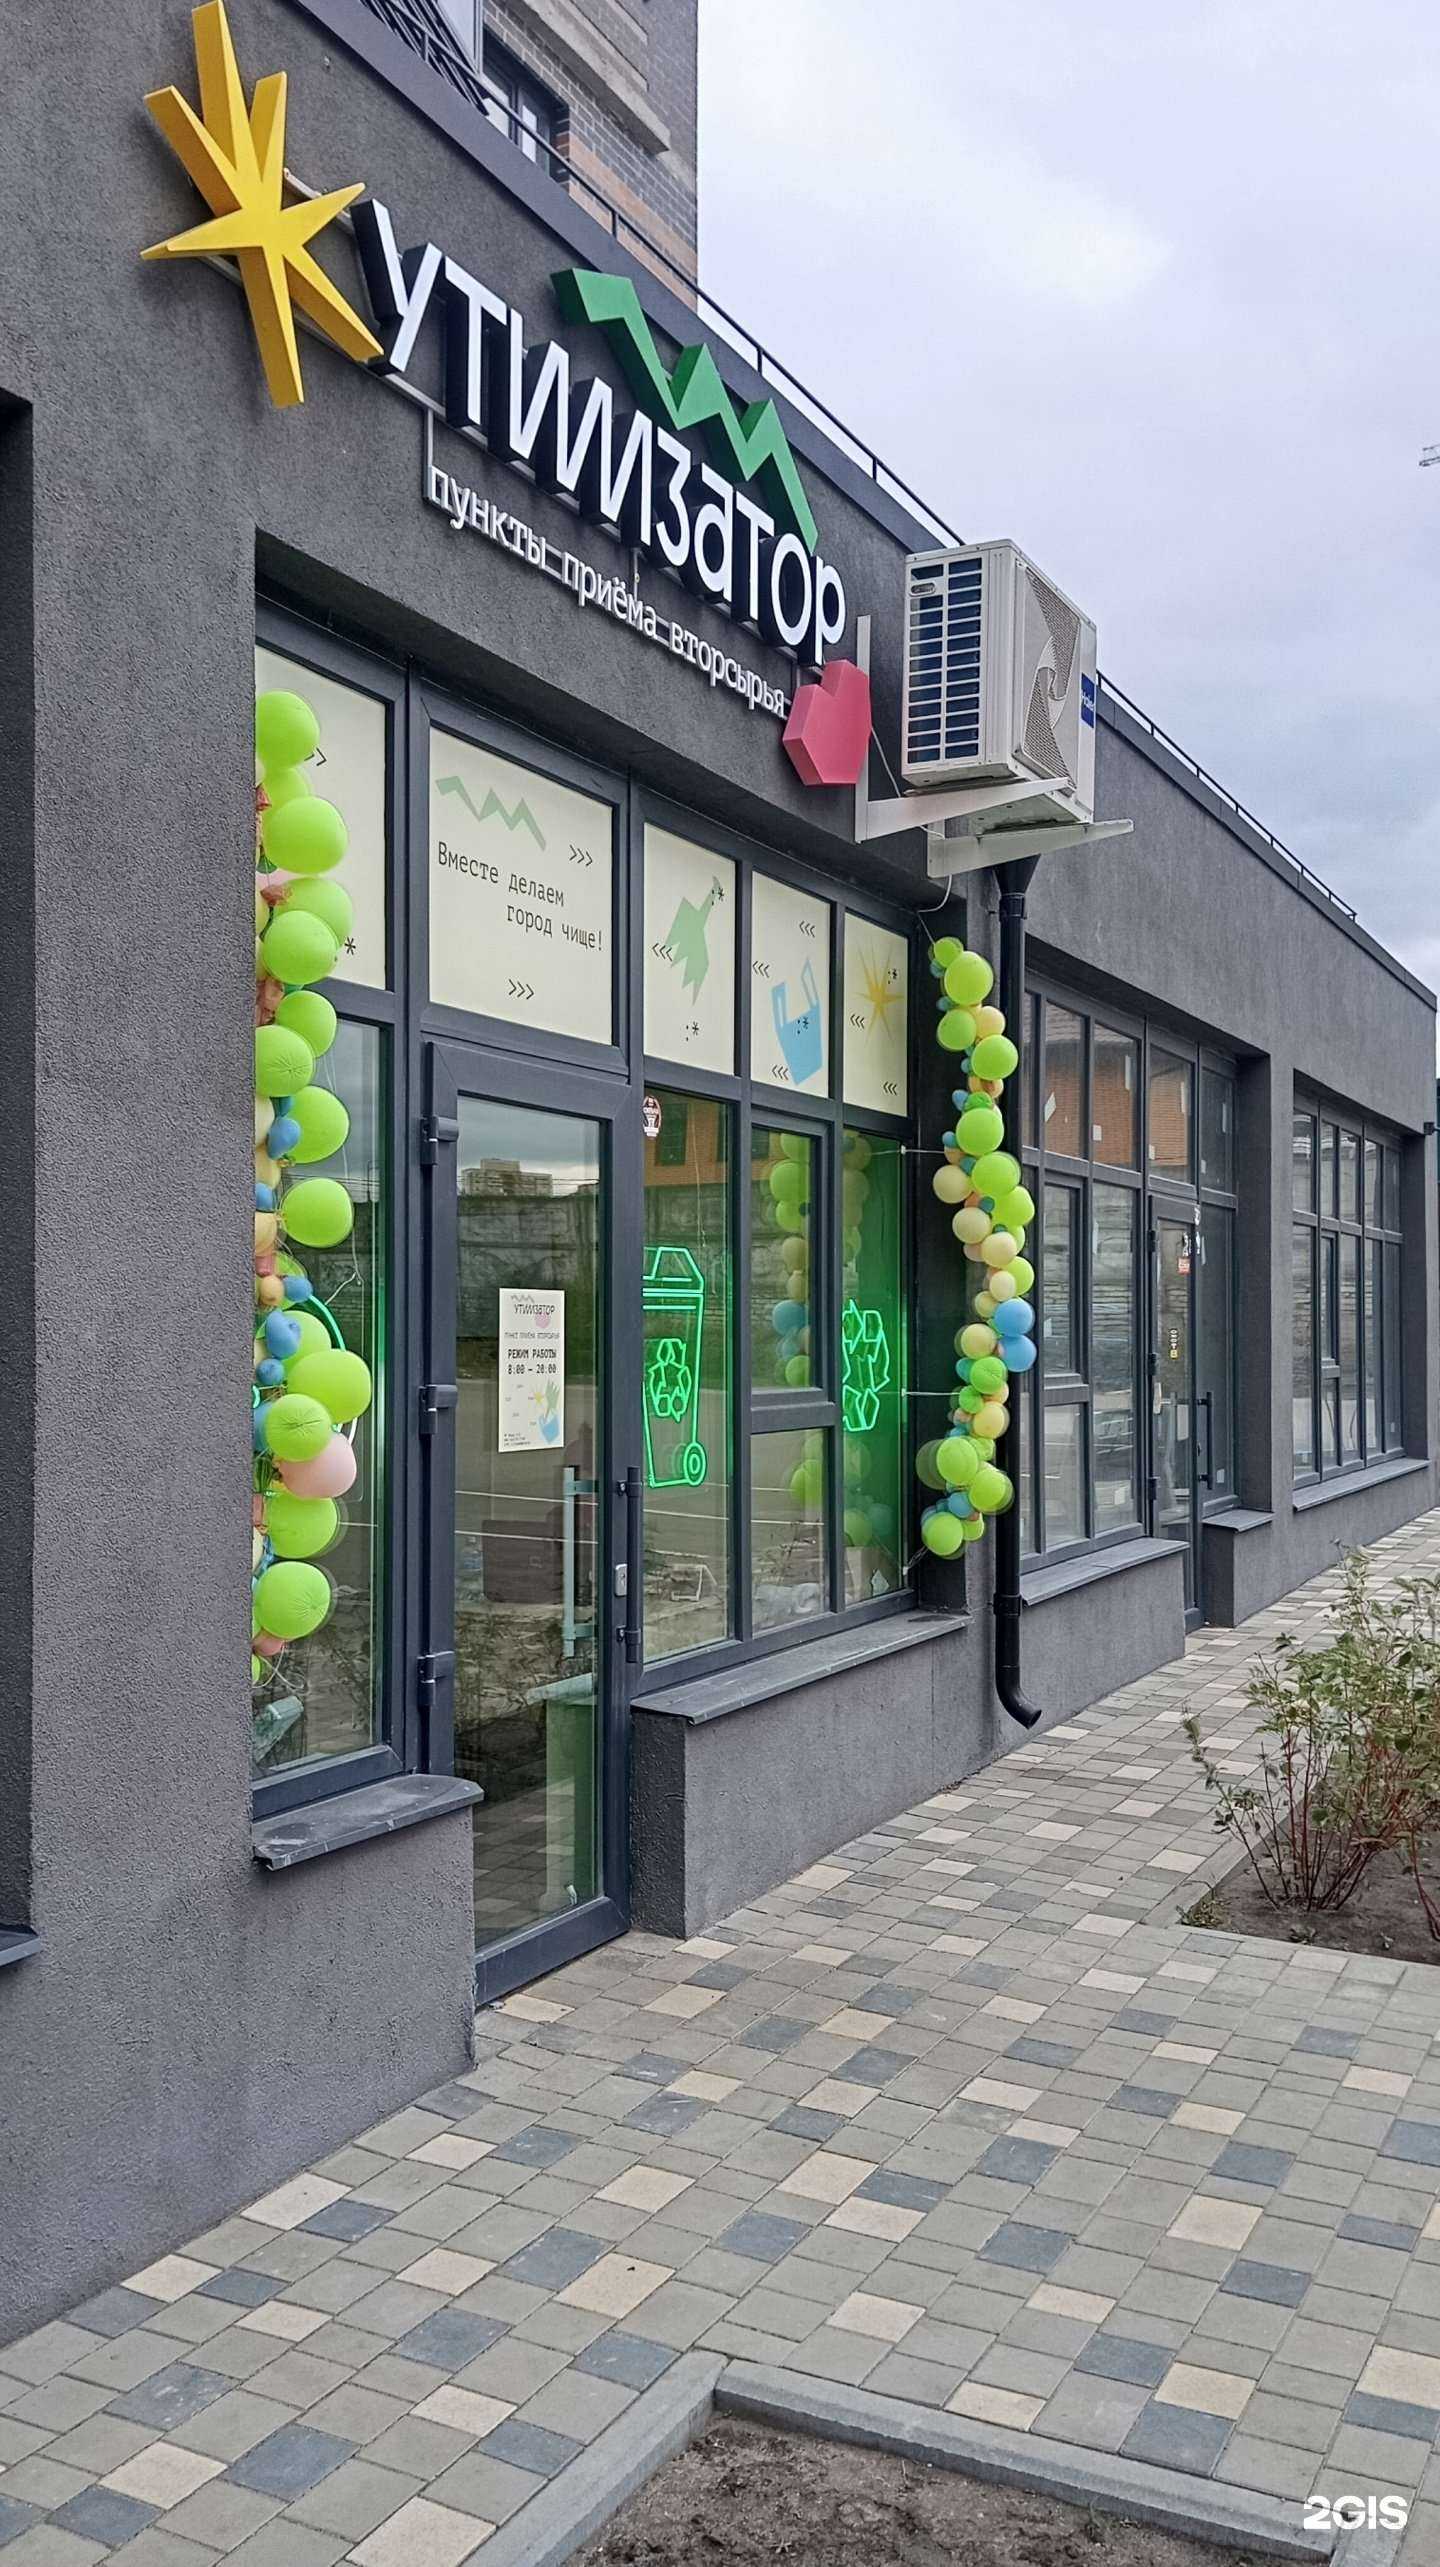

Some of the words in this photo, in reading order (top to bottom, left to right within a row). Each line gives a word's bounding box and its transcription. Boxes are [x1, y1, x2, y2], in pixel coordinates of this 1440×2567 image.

[431, 464, 547, 570] пункты
[561, 550, 656, 638] приёма
[668, 620, 786, 719] вторсырья
[437, 840, 499, 884] Вместе
[508, 873, 565, 907] делаем
[506, 904, 553, 937] город
[561, 922, 603, 952] чище!
[507, 1348, 529, 1360] РЕЖИМ
[532, 1348, 557, 1360] РАБОТЫ
[507, 1363, 526, 1375] 8:00
[536, 1363, 557, 1375] 20:00
